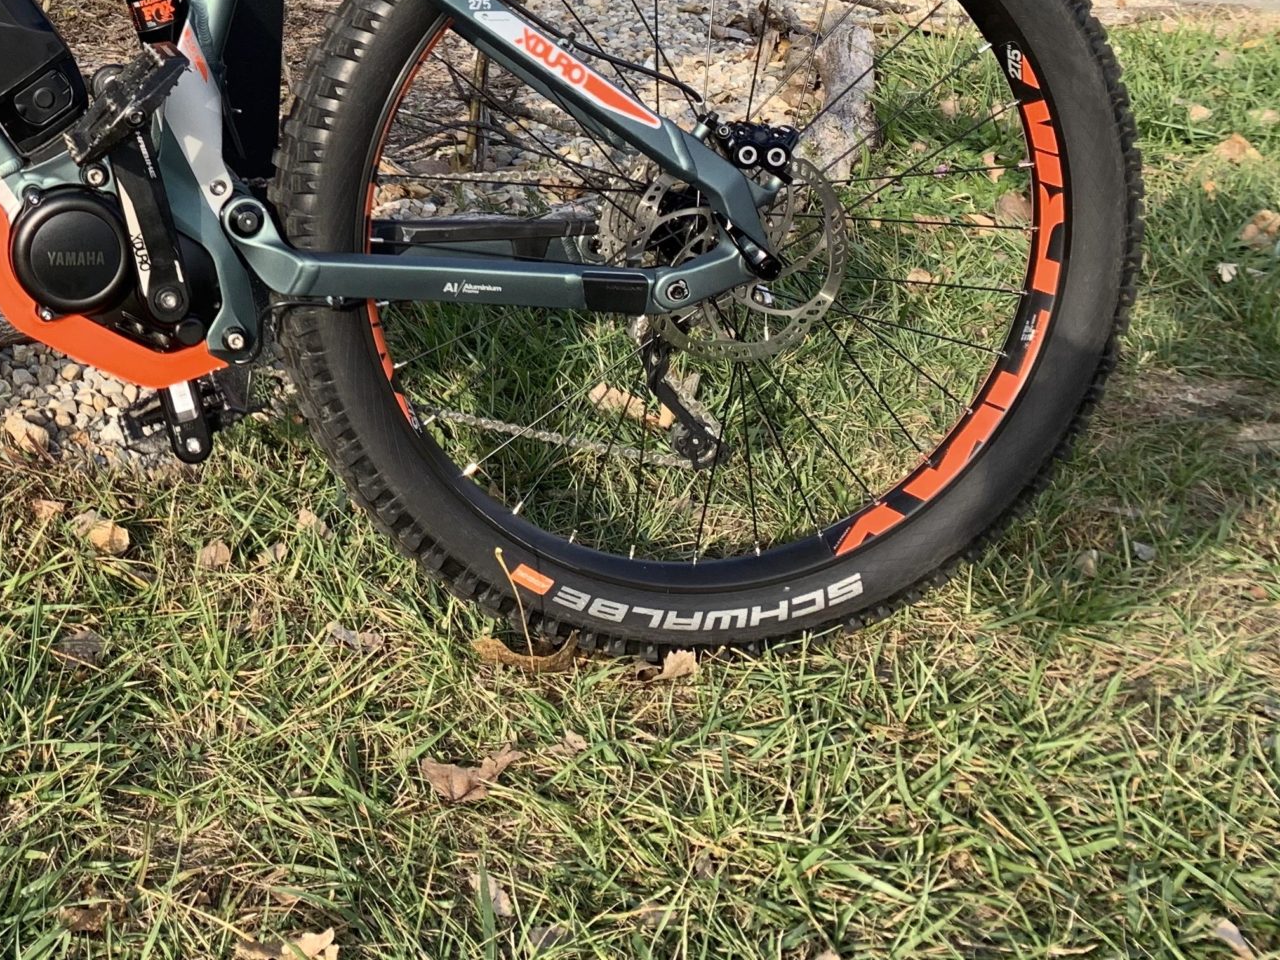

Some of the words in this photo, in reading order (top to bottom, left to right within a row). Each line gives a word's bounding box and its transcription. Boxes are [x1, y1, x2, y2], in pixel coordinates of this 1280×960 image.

[142, 0, 176, 23] FOX
[514, 27, 586, 86] XDURO
[47, 251, 105, 266] YAMAHA
[130, 233, 152, 271] XDURO
[552, 572, 864, 632] SCHWALBE
